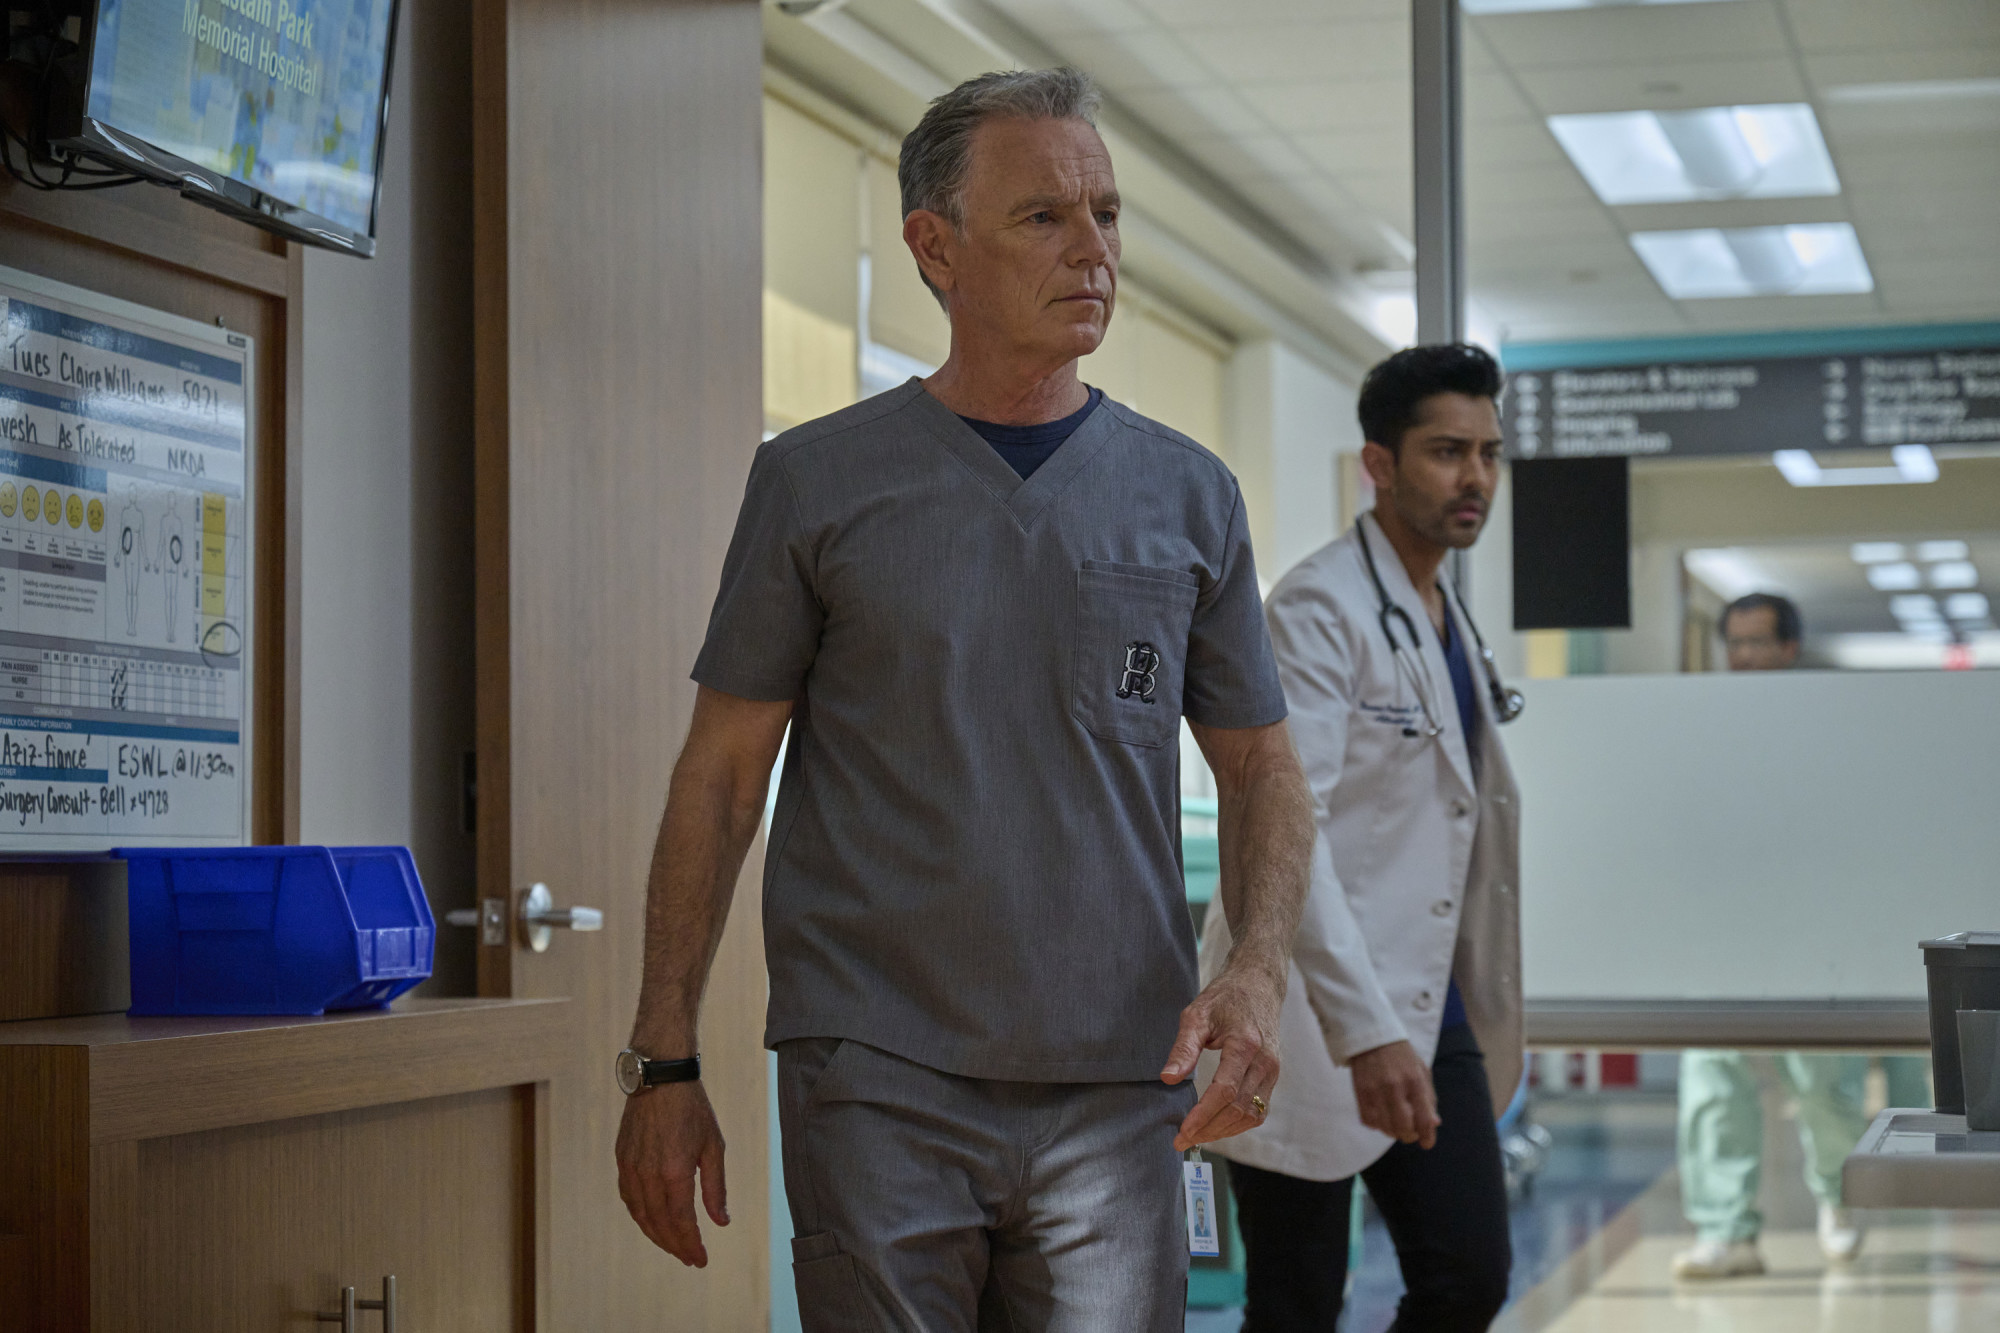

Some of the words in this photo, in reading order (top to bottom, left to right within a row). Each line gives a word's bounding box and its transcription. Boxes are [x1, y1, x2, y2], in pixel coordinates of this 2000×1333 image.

[221, 0, 271, 28] tain
[276, 0, 314, 50] Park
[182, 0, 255, 66] Memorial
[258, 36, 318, 97] Hospital
[9, 334, 51, 378] Tues
[60, 351, 102, 393] Claire
[103, 364, 165, 404] Williams
[0, 412, 38, 445] vesh
[58, 421, 73, 450] As
[75, 423, 136, 464] Tolerated
[1, 661, 13, 671] PAIN
[17, 718, 40, 728] CONTACT
[119, 743, 168, 778] ESWL
[0, 781, 44, 826] Surgery
